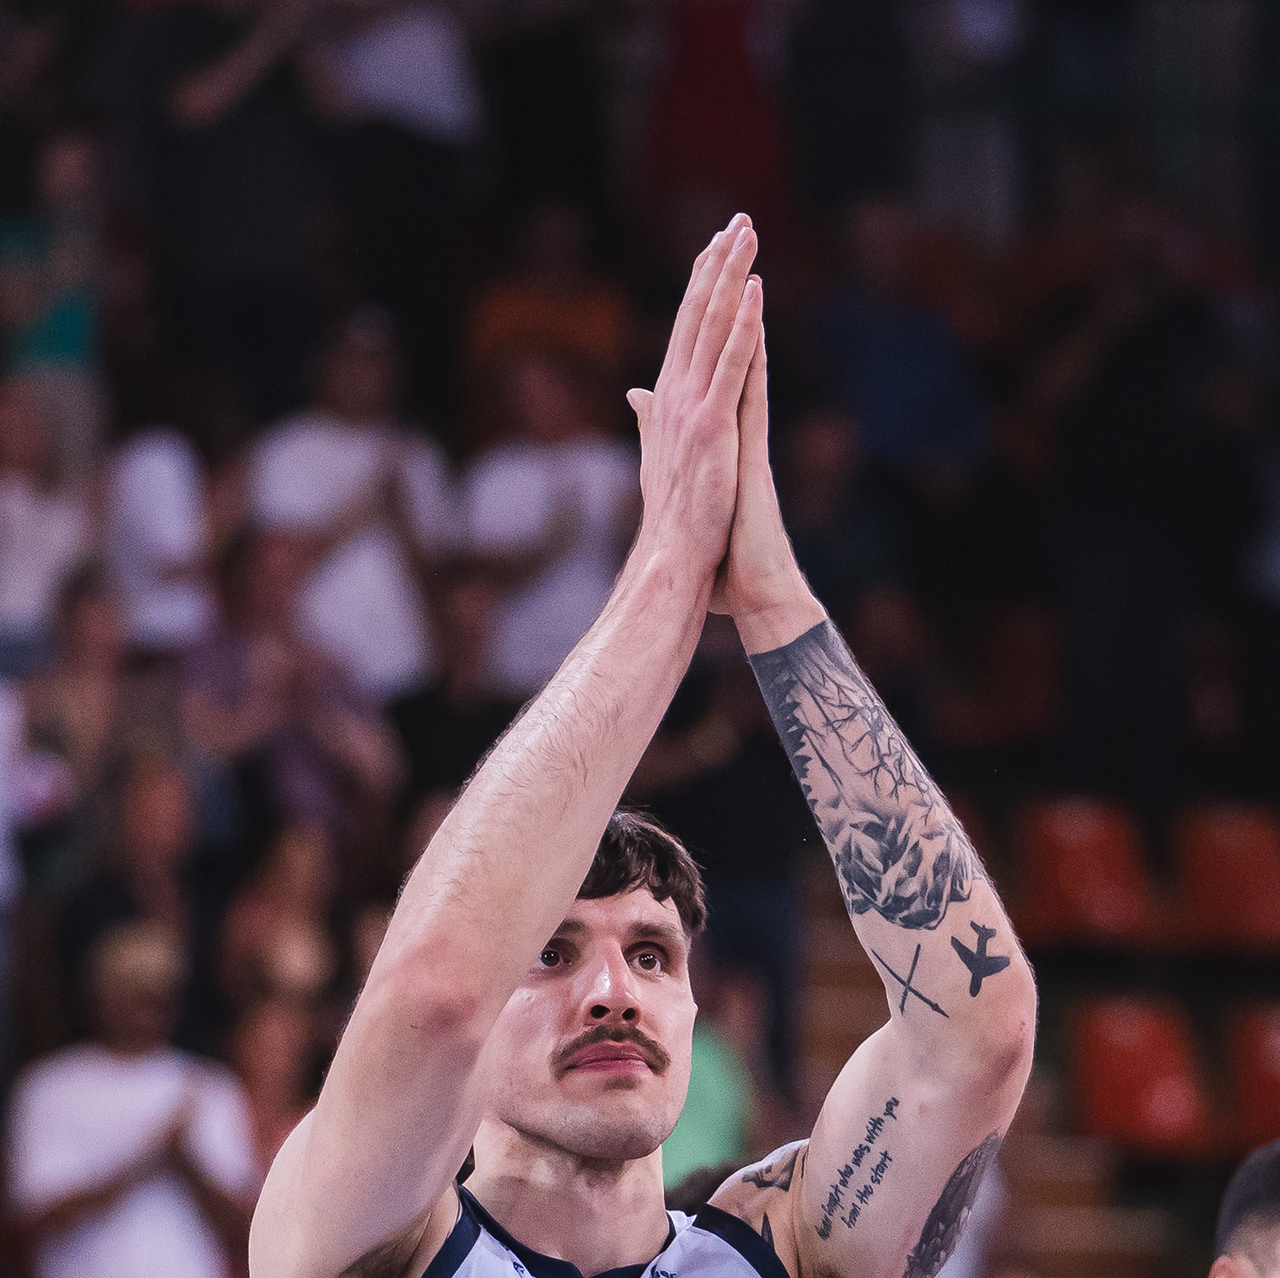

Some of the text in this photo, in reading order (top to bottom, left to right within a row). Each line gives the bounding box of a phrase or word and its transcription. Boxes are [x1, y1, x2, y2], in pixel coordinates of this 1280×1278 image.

[852, 1143, 870, 1167] was
[864, 1116, 885, 1144] with
[883, 1096, 900, 1121] you
[870, 1150, 893, 1185] start
